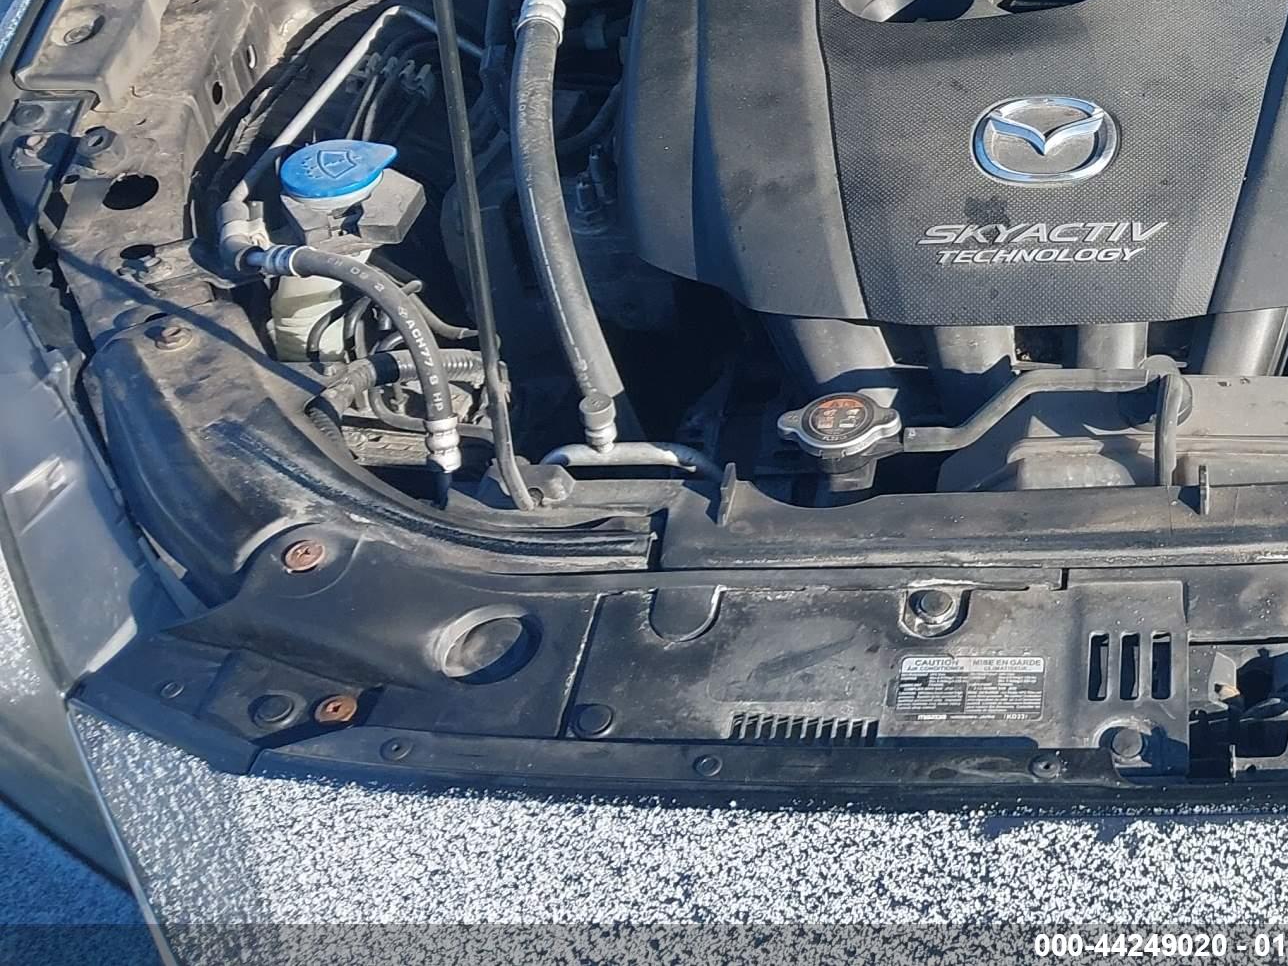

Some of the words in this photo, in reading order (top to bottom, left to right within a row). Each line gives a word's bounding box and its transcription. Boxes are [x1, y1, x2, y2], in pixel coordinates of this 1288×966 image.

[917, 220, 1168, 246] SKYACTIV
[937, 247, 1146, 266] TECHNOLOGY
[914, 659, 960, 667] CAUTION
